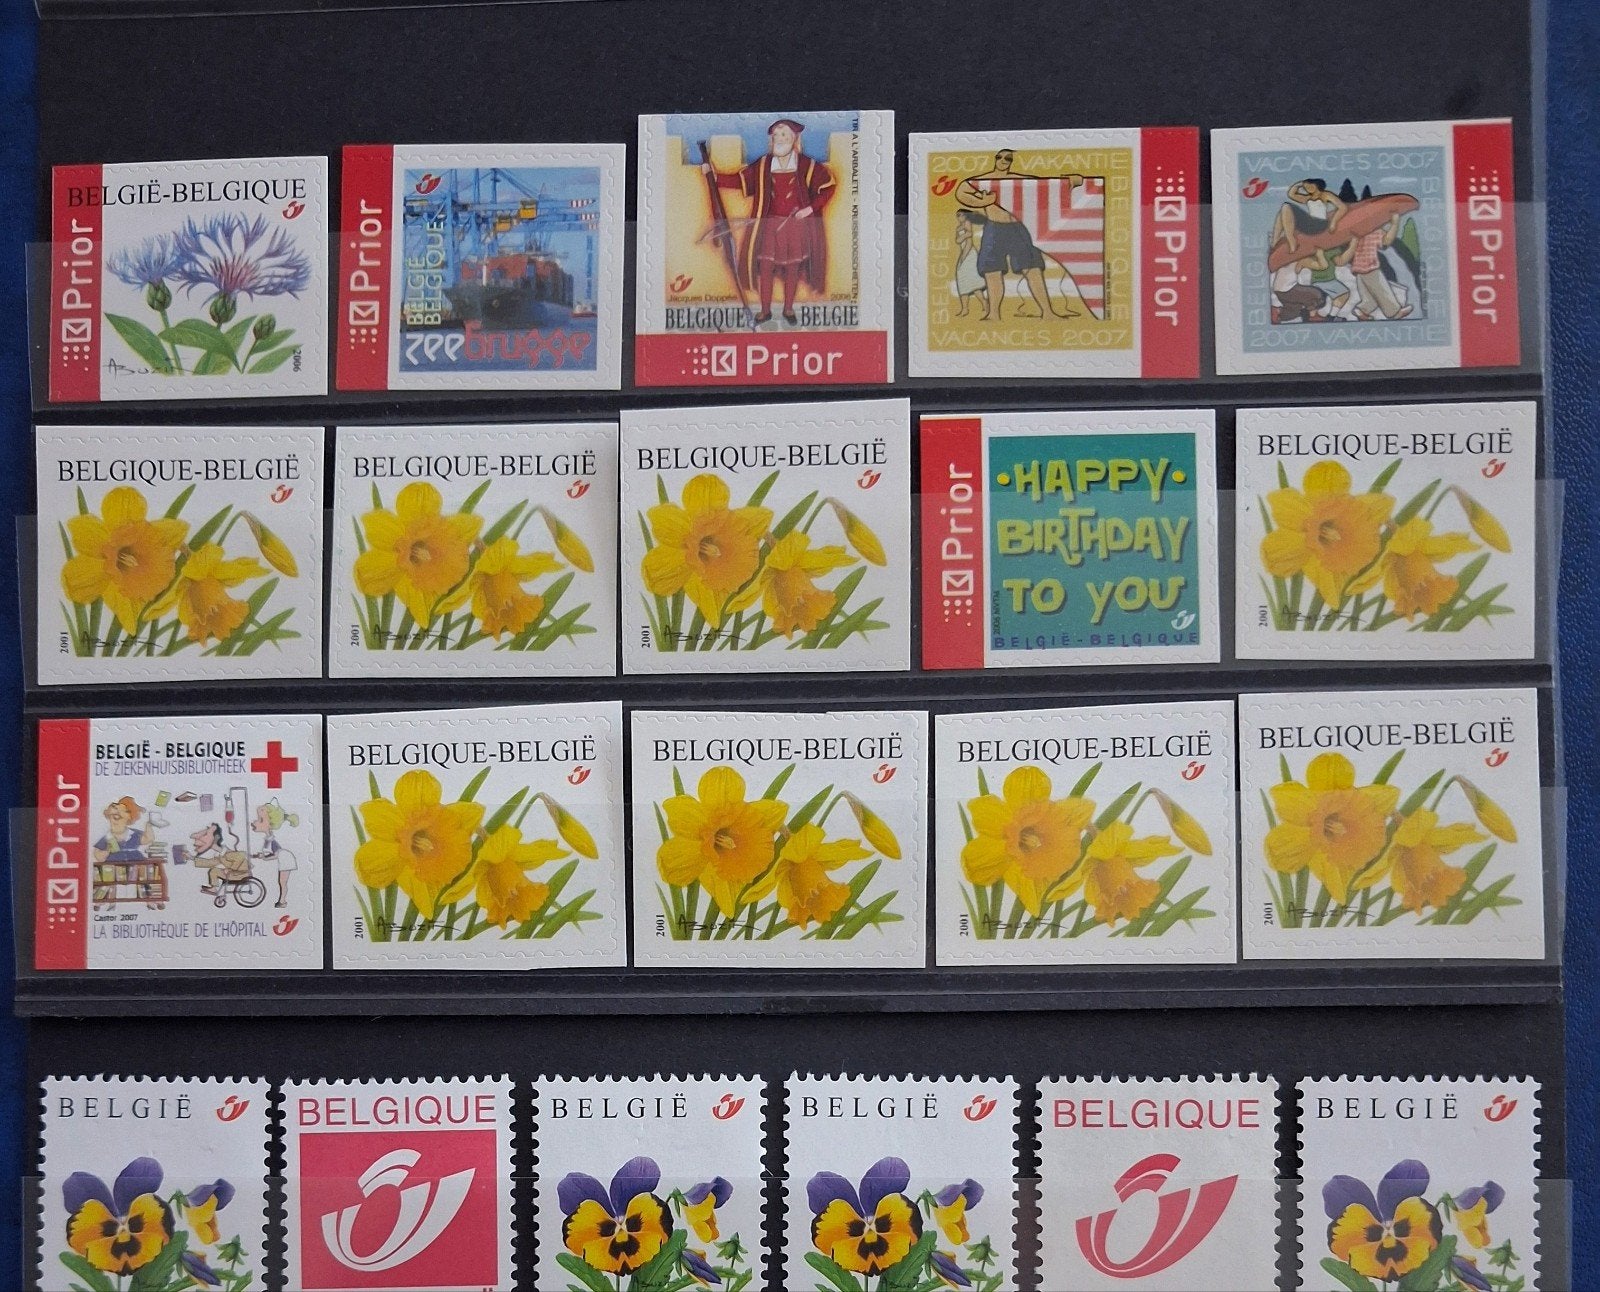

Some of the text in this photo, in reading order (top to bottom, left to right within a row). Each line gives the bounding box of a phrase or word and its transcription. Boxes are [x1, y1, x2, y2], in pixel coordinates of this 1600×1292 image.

[851, 118, 859, 132] TIR
[932, 152, 1129, 173] 2007 VAKANTIE
[1244, 151, 1439, 173] VACANCES 2007
[67, 178, 307, 207] BELGIË-BELGIQUE
[350, 199, 382, 292] Prior
[1110, 177, 1129, 320] BELGIQUE
[1422, 175, 1445, 320] BELGIQUE
[62, 218, 93, 310] Prior
[424, 221, 444, 325] BELGIQUE
[1470, 229, 1505, 324] Prior
[1154, 231, 1187, 327] Prior
[665, 307, 745, 332] BELGIQUE
[932, 328, 1128, 347] VACANCES 2007
[1249, 323, 1445, 348] 2007 VAKANTIE
[292, 349, 302, 373] 2006
[746, 343, 843, 376] Prior
[637, 437, 887, 474] BELGIQUE-BELGIË
[1258, 427, 1513, 460] BELGIQUE-BELGIË
[57, 454, 300, 487] BELGIQUE-BELGIË
[353, 449, 597, 482] BELGIQUE-BELGIË
[1013, 458, 1169, 502] HAPPY
[941, 463, 974, 560] Prior
[996, 508, 1189, 566] BIRTHDAY
[1002, 578, 1066, 613] TO
[1258, 604, 1268, 627] 2001
[60, 631, 69, 654] 2001
[350, 624, 360, 647] 2001
[641, 624, 651, 649] 2001
[652, 732, 903, 766] BELGIQUE-BELGIË
[957, 730, 1213, 765] BELGIQUE-BELGIË
[1259, 717, 1515, 752] BELGIQUE-BELGIË
[96, 740, 150, 760] BELGIË
[166, 741, 246, 759] BELGIQUE
[348, 735, 597, 769] BELGIQUE-BELGIË
[95, 759, 246, 776] DE ZIEKENHUISBIBLIOTHEEK
[48, 775, 81, 869] Prior
[120, 913, 138, 922] 2007
[354, 916, 364, 939] 2001
[655, 913, 665, 937] 2001
[959, 913, 969, 936] 2001
[1263, 901, 1273, 926] 2001
[93, 920, 268, 939] LA BIBLIOTHÈQUE DE L'HÔPITAL
[58, 1093, 192, 1120] BELGIË
[299, 1095, 496, 1126] BELGIQUE
[551, 1092, 687, 1119] BELGIË
[801, 1092, 939, 1119] BELGIË
[1053, 1098, 1260, 1129] BELGIQUE
[1317, 1093, 1459, 1120] BELGIË
